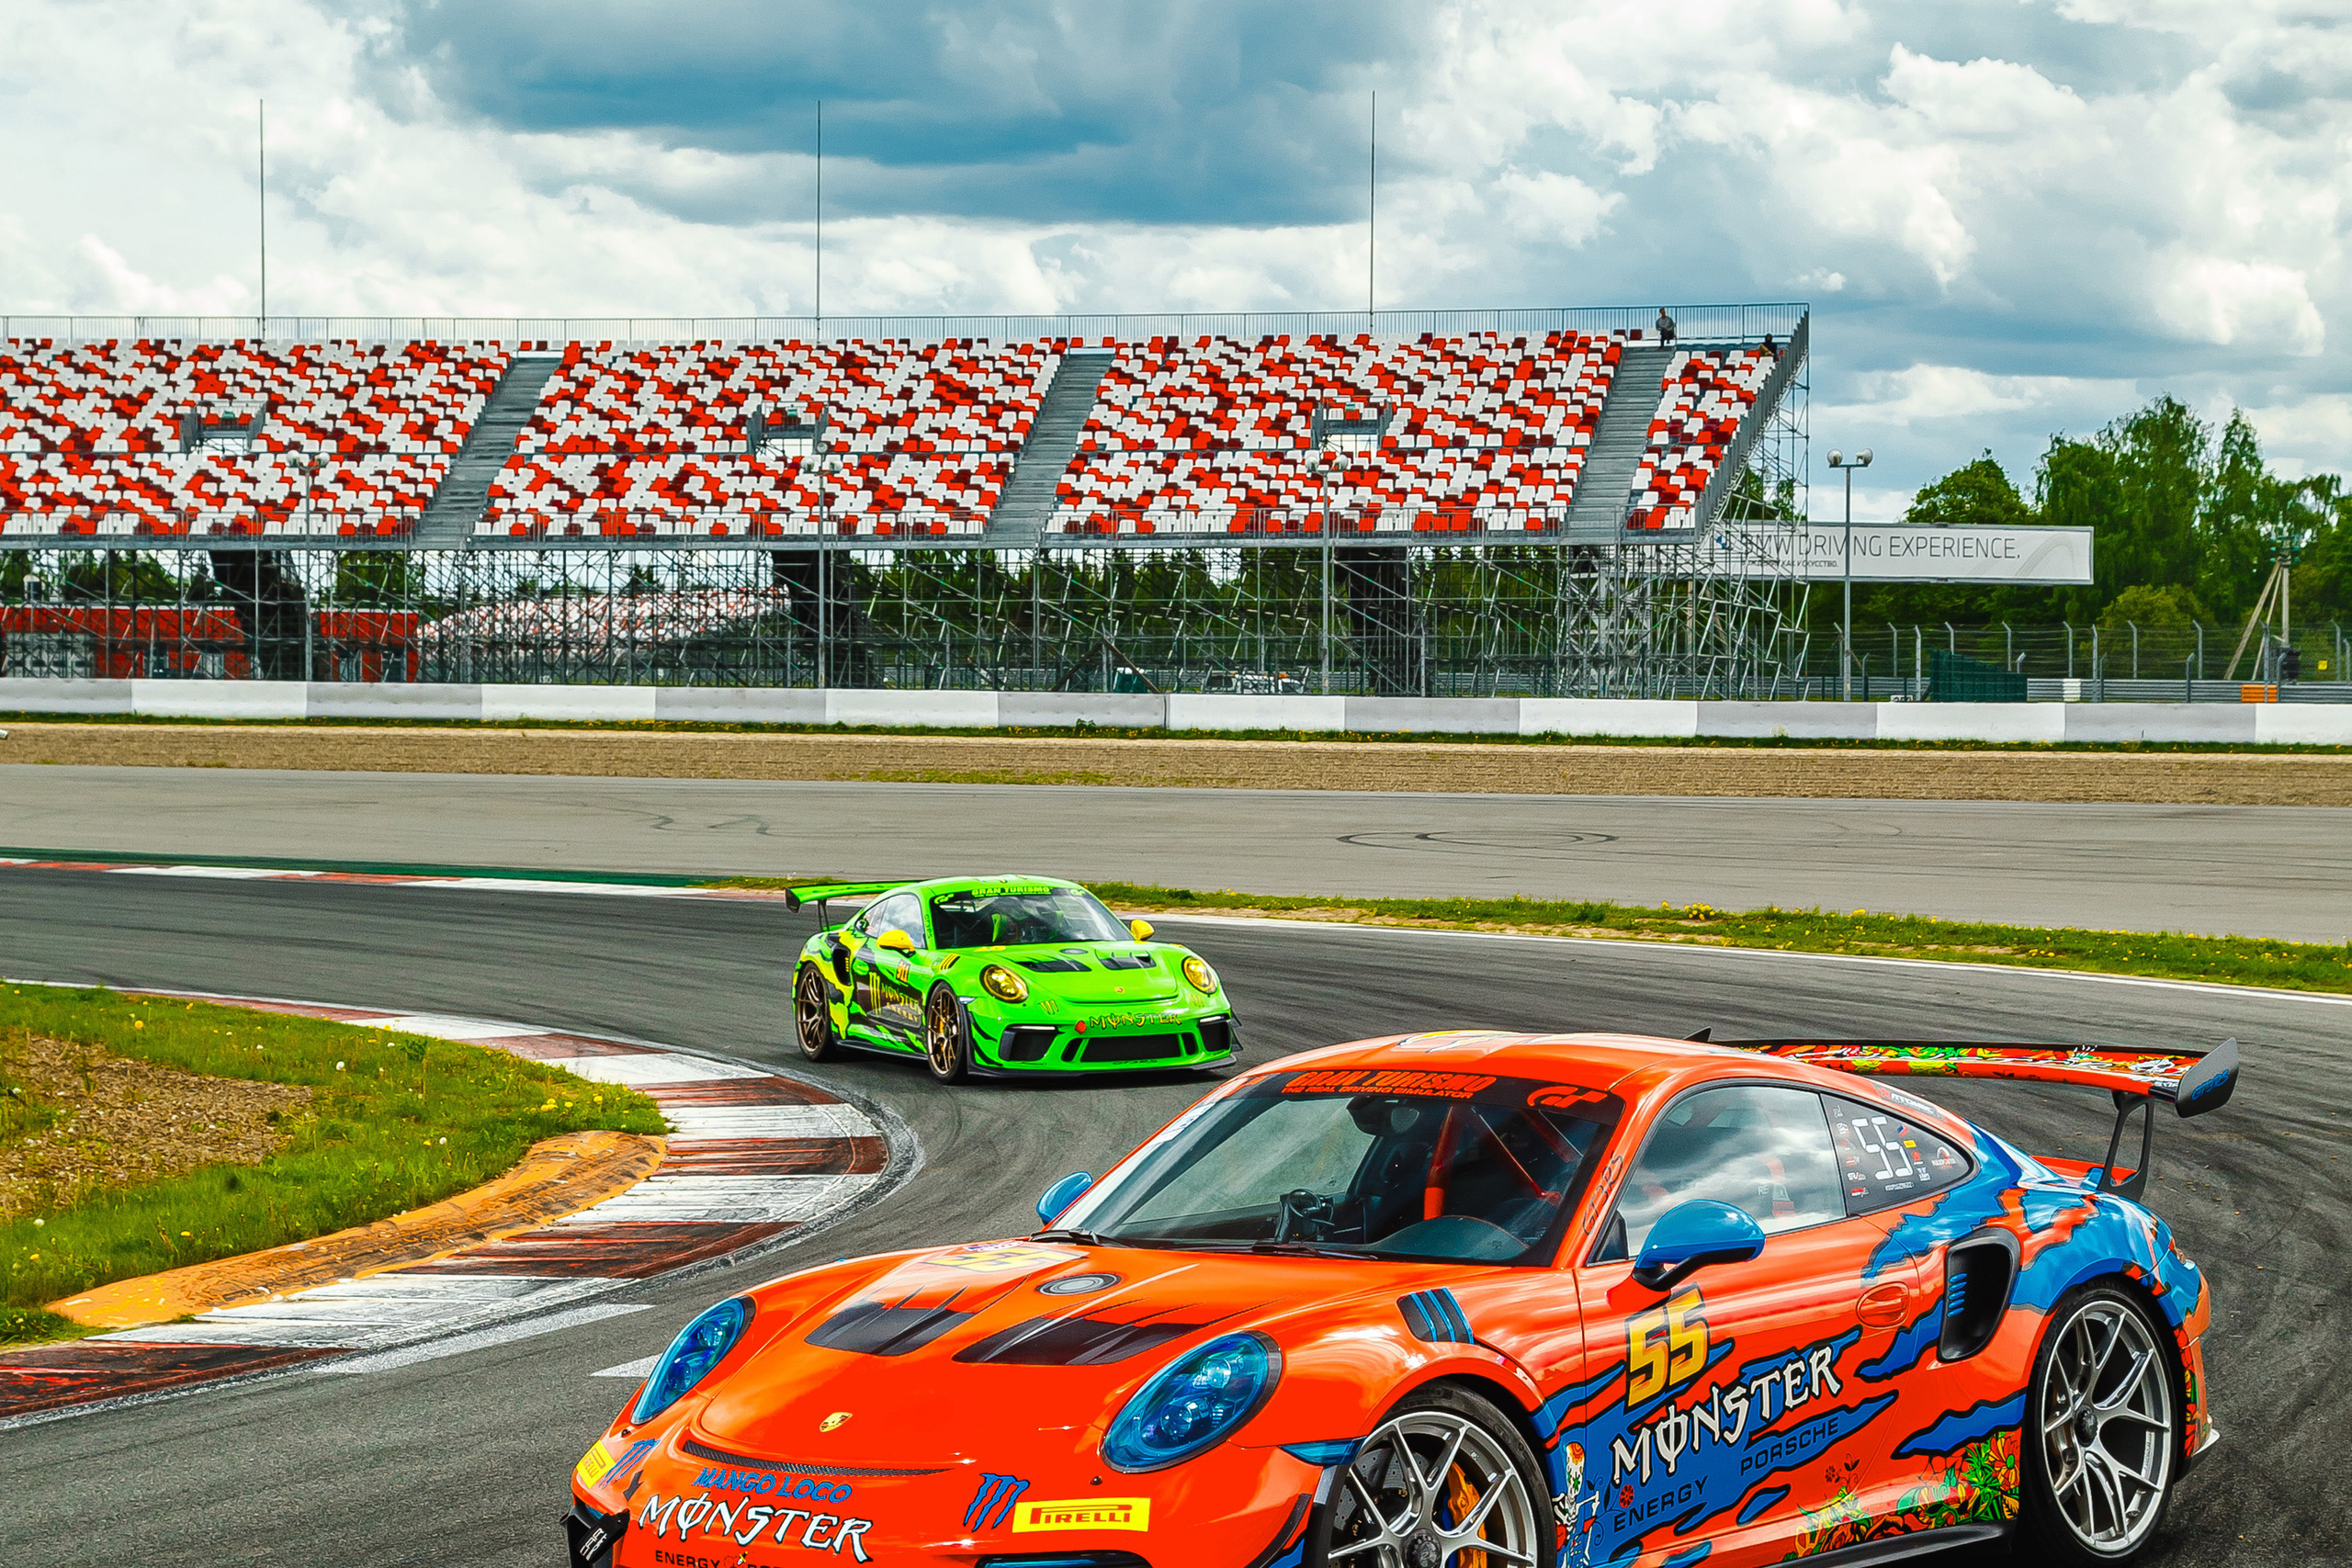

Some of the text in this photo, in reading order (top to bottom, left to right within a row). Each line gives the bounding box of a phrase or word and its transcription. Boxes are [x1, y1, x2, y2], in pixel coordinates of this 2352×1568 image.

[1798, 535, 1883, 557] DRIVNG
[1889, 536, 2021, 559] EXPERIENCE.
[971, 888, 1001, 897] GRAN
[1089, 1011, 1182, 1031] MONSTER
[1286, 1071, 1497, 1093] GRAN TURISMO
[1339, 1086, 1393, 1094] DRIVING
[1392, 1088, 1475, 1100] SIMULATOR
[1851, 1116, 1914, 1180] 55
[1625, 1282, 1710, 1409] 55
[1611, 1345, 1842, 1485] MONSTER
[1740, 1416, 1840, 1477] PORSCHE
[692, 1468, 853, 1504] MANGO LOCO
[1029, 1504, 1133, 1525] PIRELLI
[1614, 1475, 1709, 1533] ENERGY
[638, 1492, 874, 1563] MONSTER
[655, 1550, 721, 1568] ENERGY
